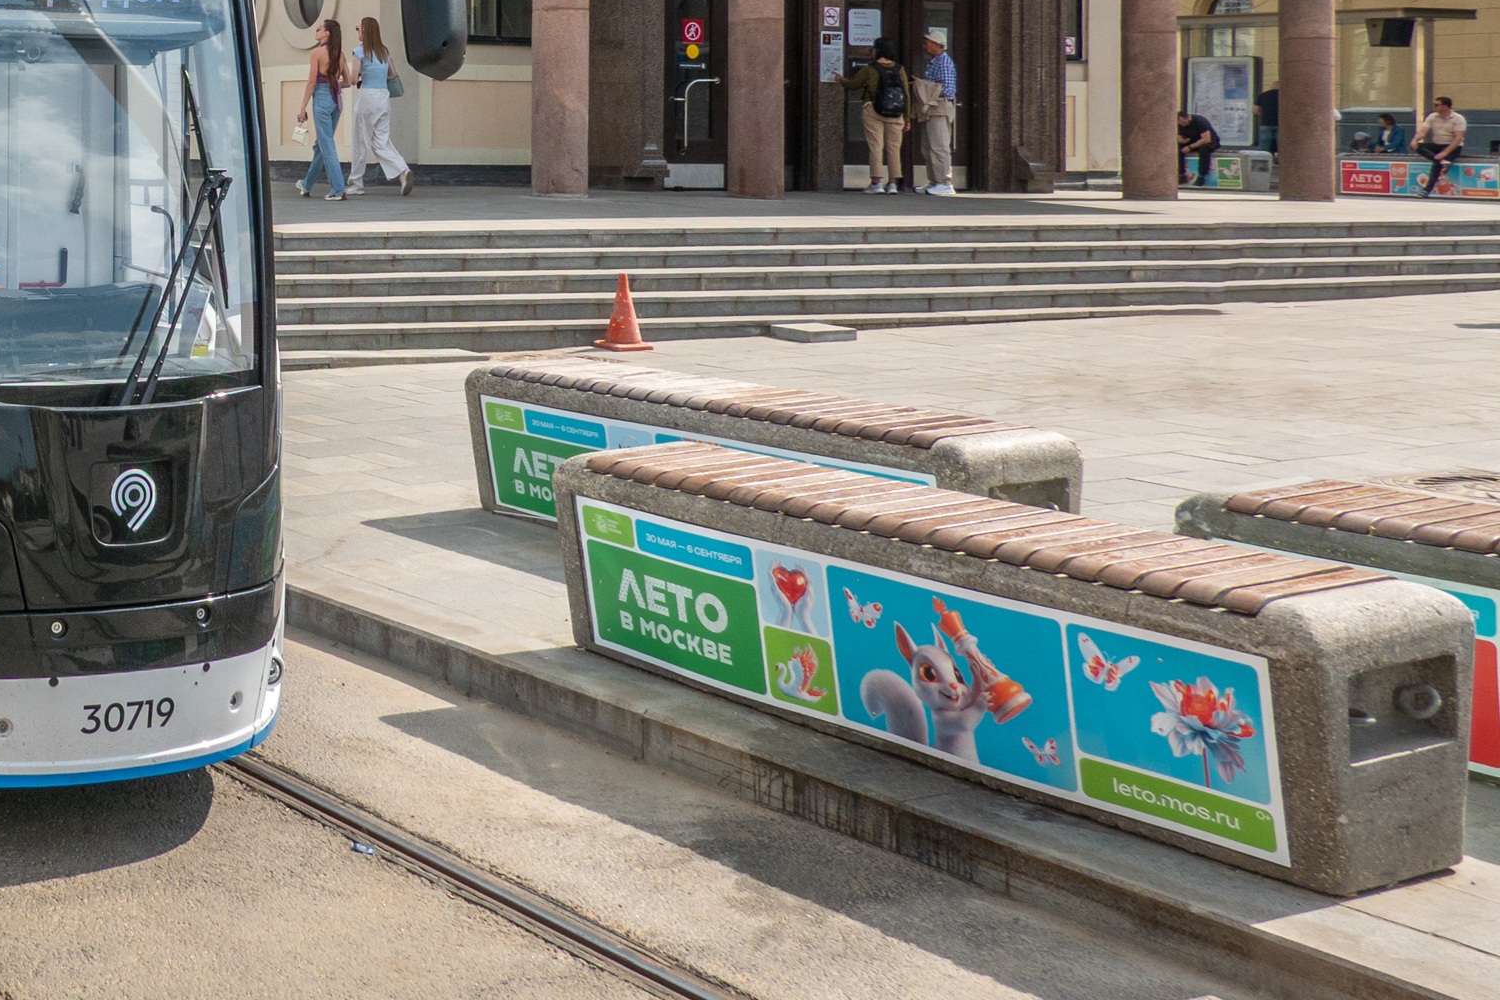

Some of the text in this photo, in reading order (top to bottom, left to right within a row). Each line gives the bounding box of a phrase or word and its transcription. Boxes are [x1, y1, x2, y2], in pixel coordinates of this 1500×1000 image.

[1350, 173, 1382, 183] ЛЕТО
[514, 479, 526, 495] В
[645, 533, 657, 544] 30
[657, 536, 677, 549] МАЯ
[686, 544, 694, 554] 6
[694, 547, 743, 566] СЕНТЯБРЯ
[618, 568, 729, 633] ЛЕТО
[619, 610, 733, 666] В МОСКВЕ
[80, 697, 175, 735] 30719
[1112, 777, 1241, 831] leto.mos.ru
